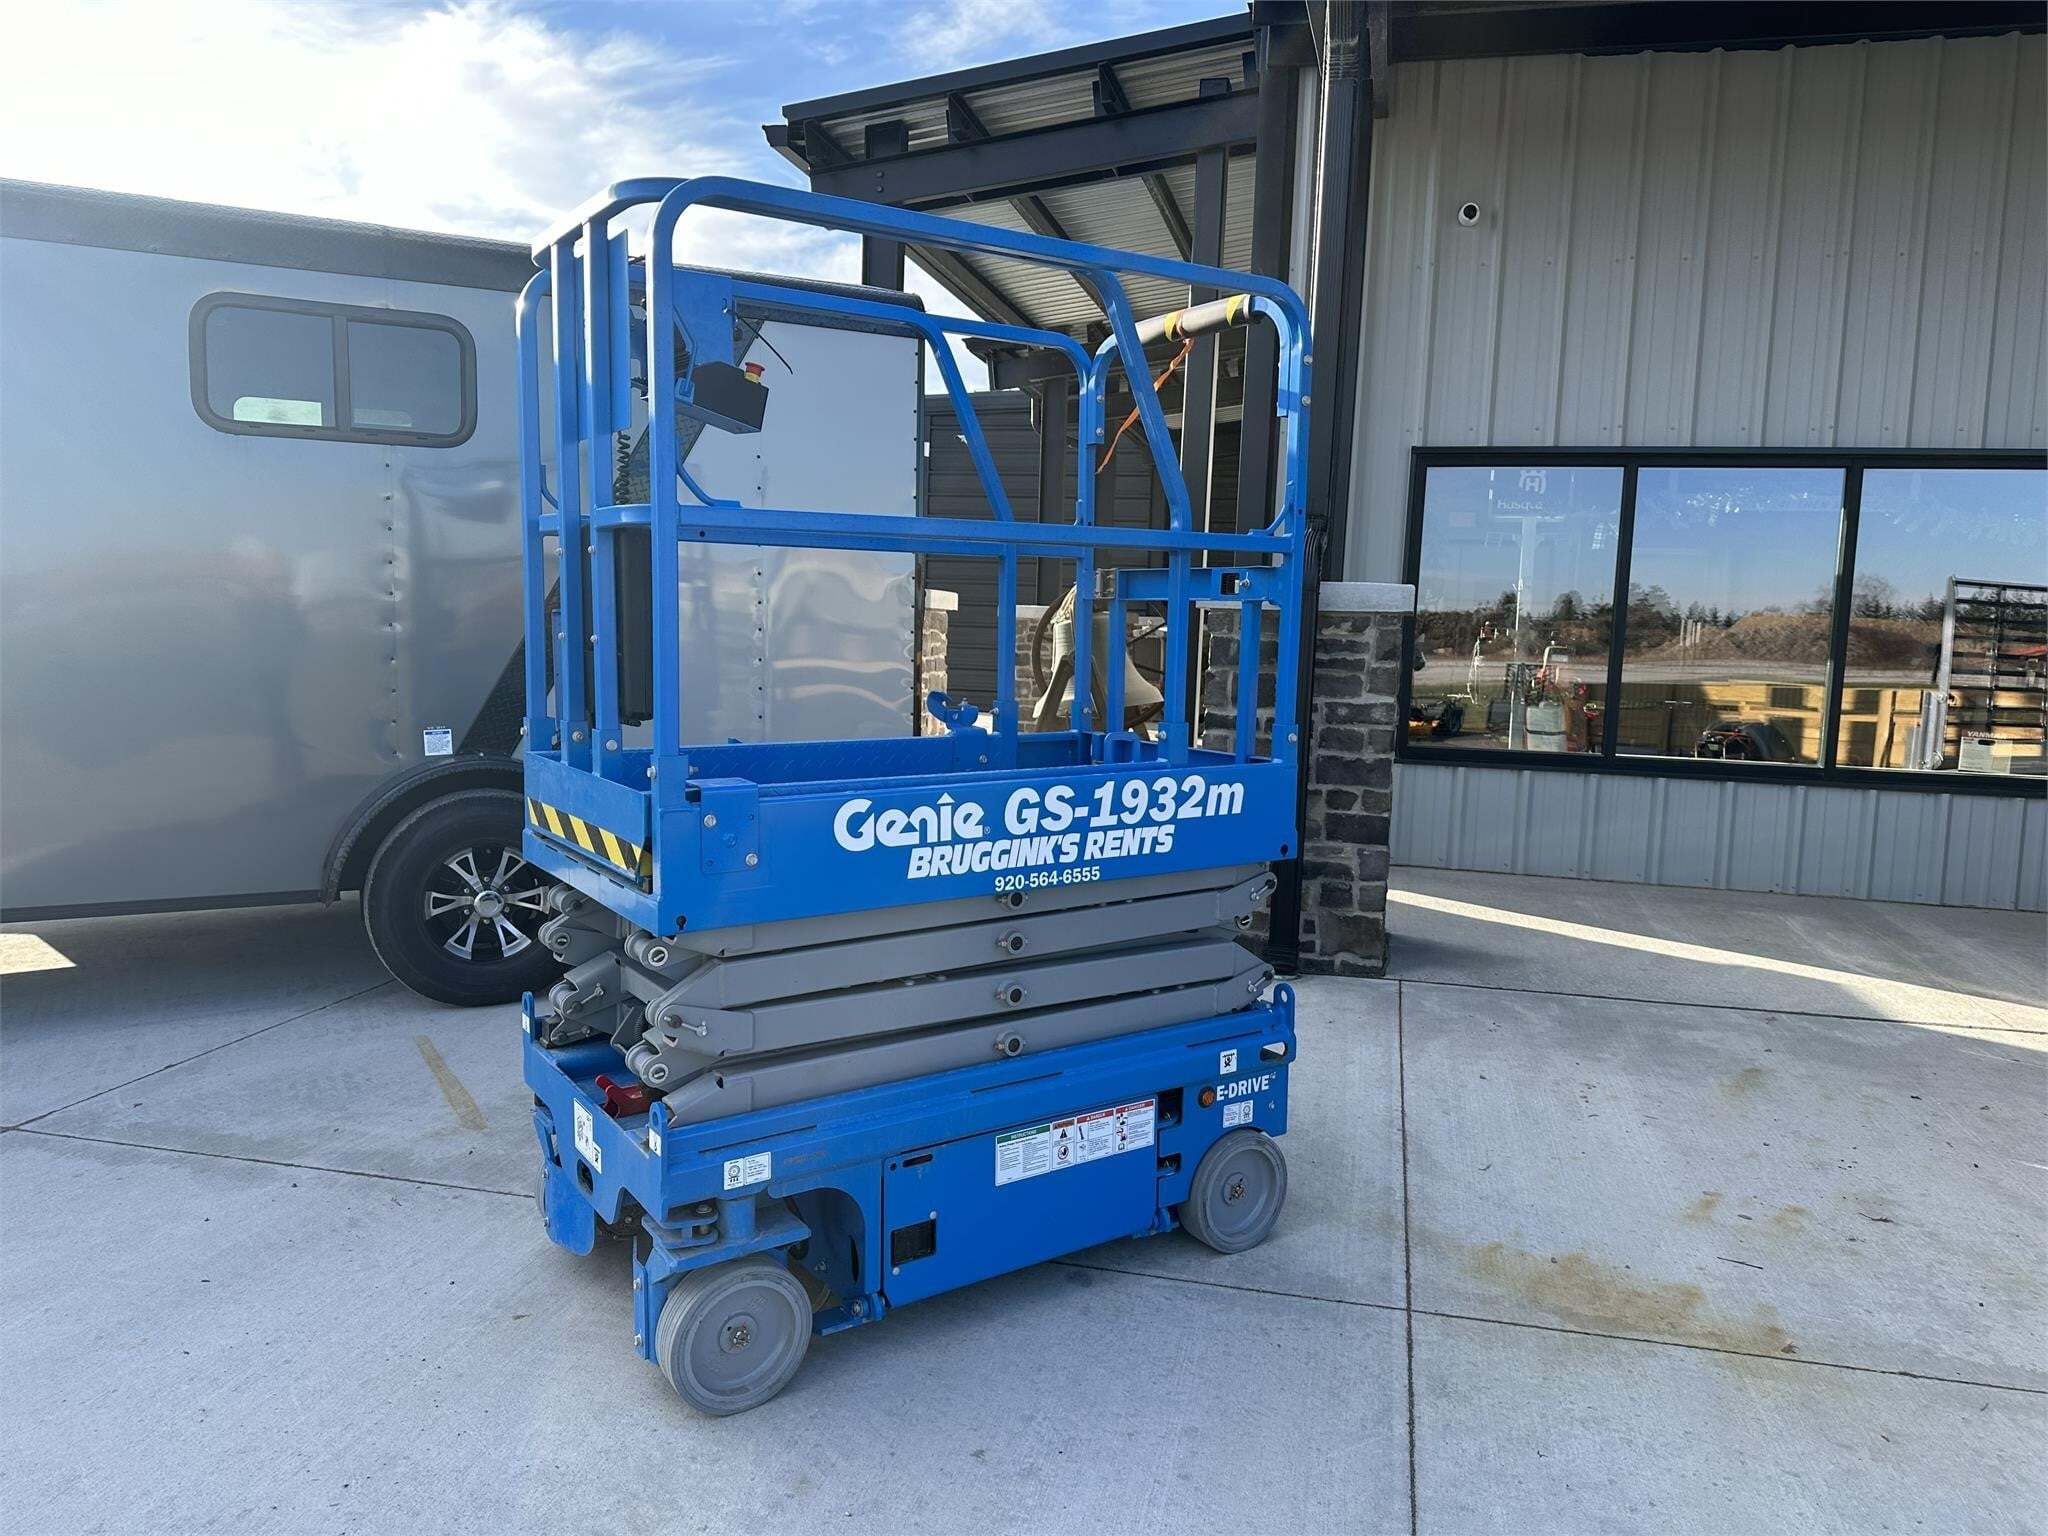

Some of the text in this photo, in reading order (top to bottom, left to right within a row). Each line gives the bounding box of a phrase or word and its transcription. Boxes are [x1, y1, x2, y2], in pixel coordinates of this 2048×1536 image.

[833, 775, 1245, 852] Genie GS-1932m
[907, 824, 1176, 879] BRUGGINK'S RENTS
[994, 865, 1101, 891] 920-564-6555
[1216, 1074, 1270, 1101] E-DRIVE
